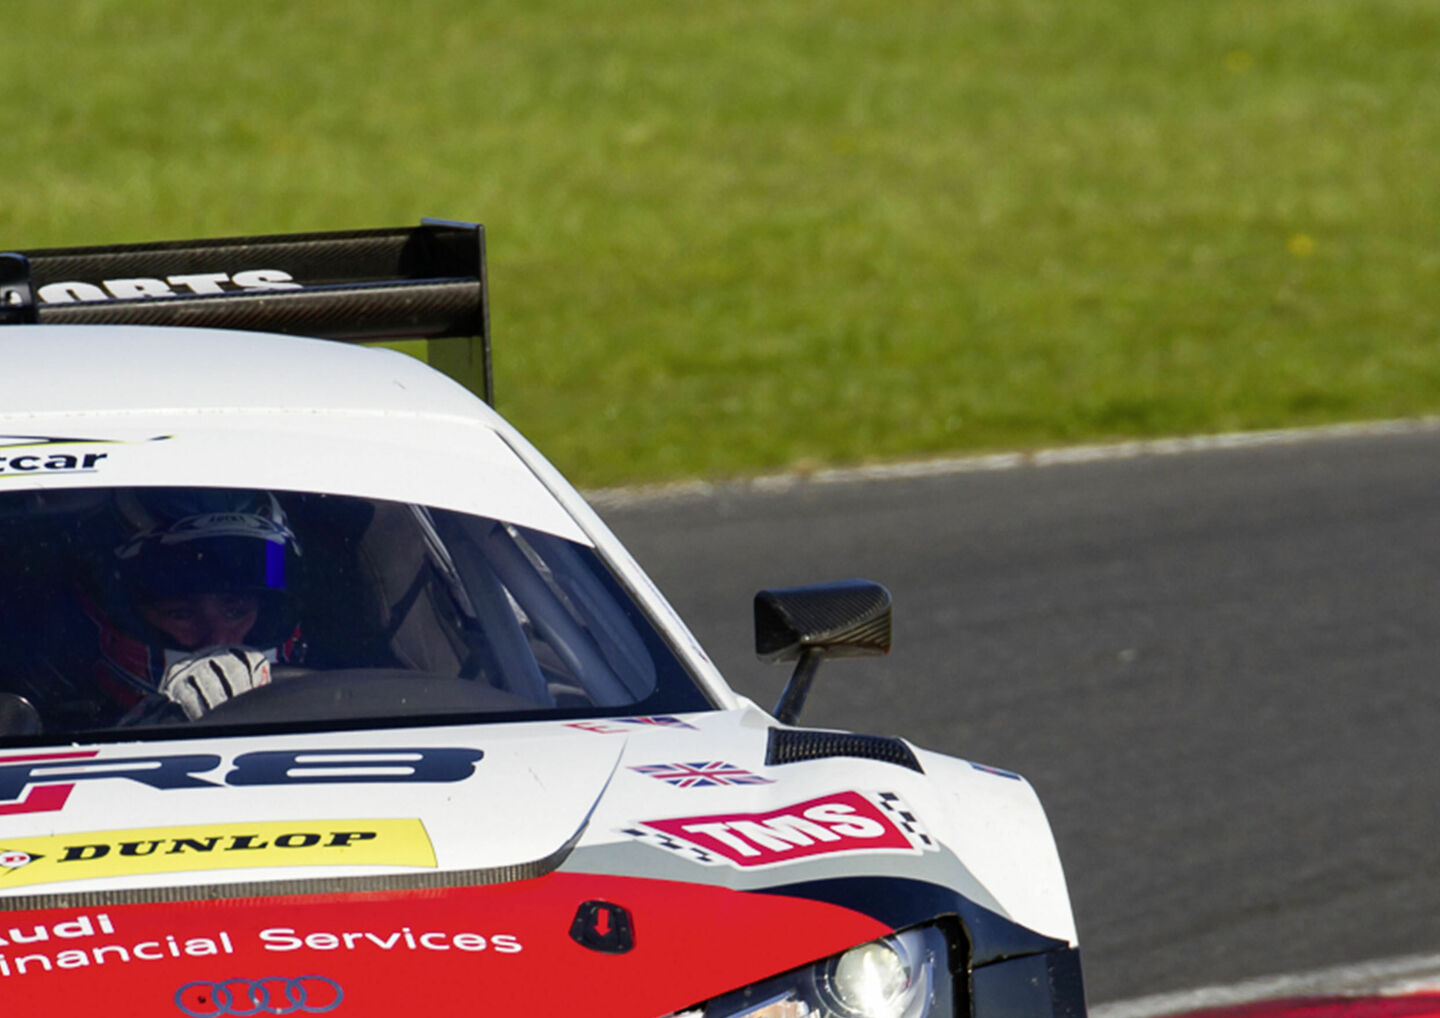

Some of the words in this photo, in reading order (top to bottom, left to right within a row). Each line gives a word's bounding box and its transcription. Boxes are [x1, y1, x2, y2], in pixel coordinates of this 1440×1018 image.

[681, 803, 886, 857] TMS
[56, 831, 378, 864] DUNLOP
[259, 927, 523, 955] Services
